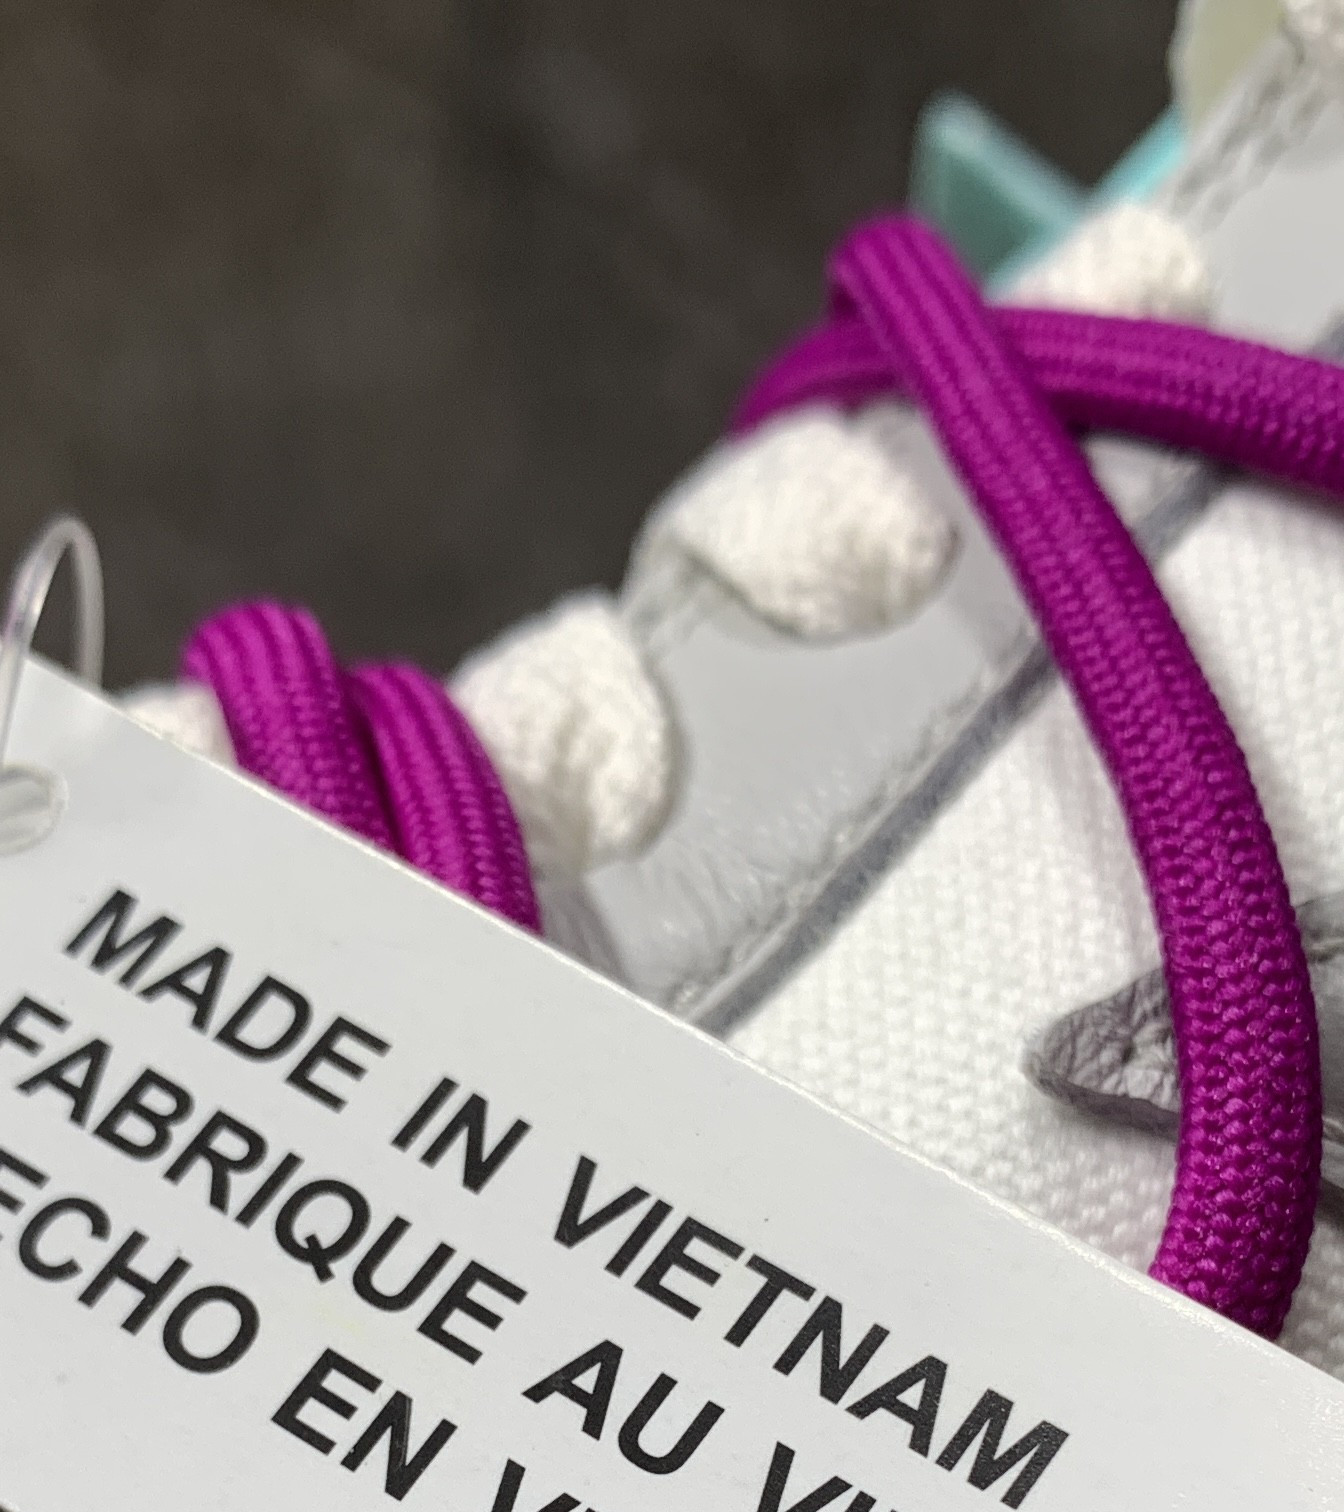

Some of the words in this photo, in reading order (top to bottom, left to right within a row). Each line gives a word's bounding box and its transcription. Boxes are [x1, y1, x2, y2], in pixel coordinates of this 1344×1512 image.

[64, 889, 392, 1112] MADE
[389, 1075, 532, 1196] IN
[552, 1153, 1072, 1512] VIETNAM
[269, 1345, 460, 1504] EN
[519, 1337, 727, 1477] AU
